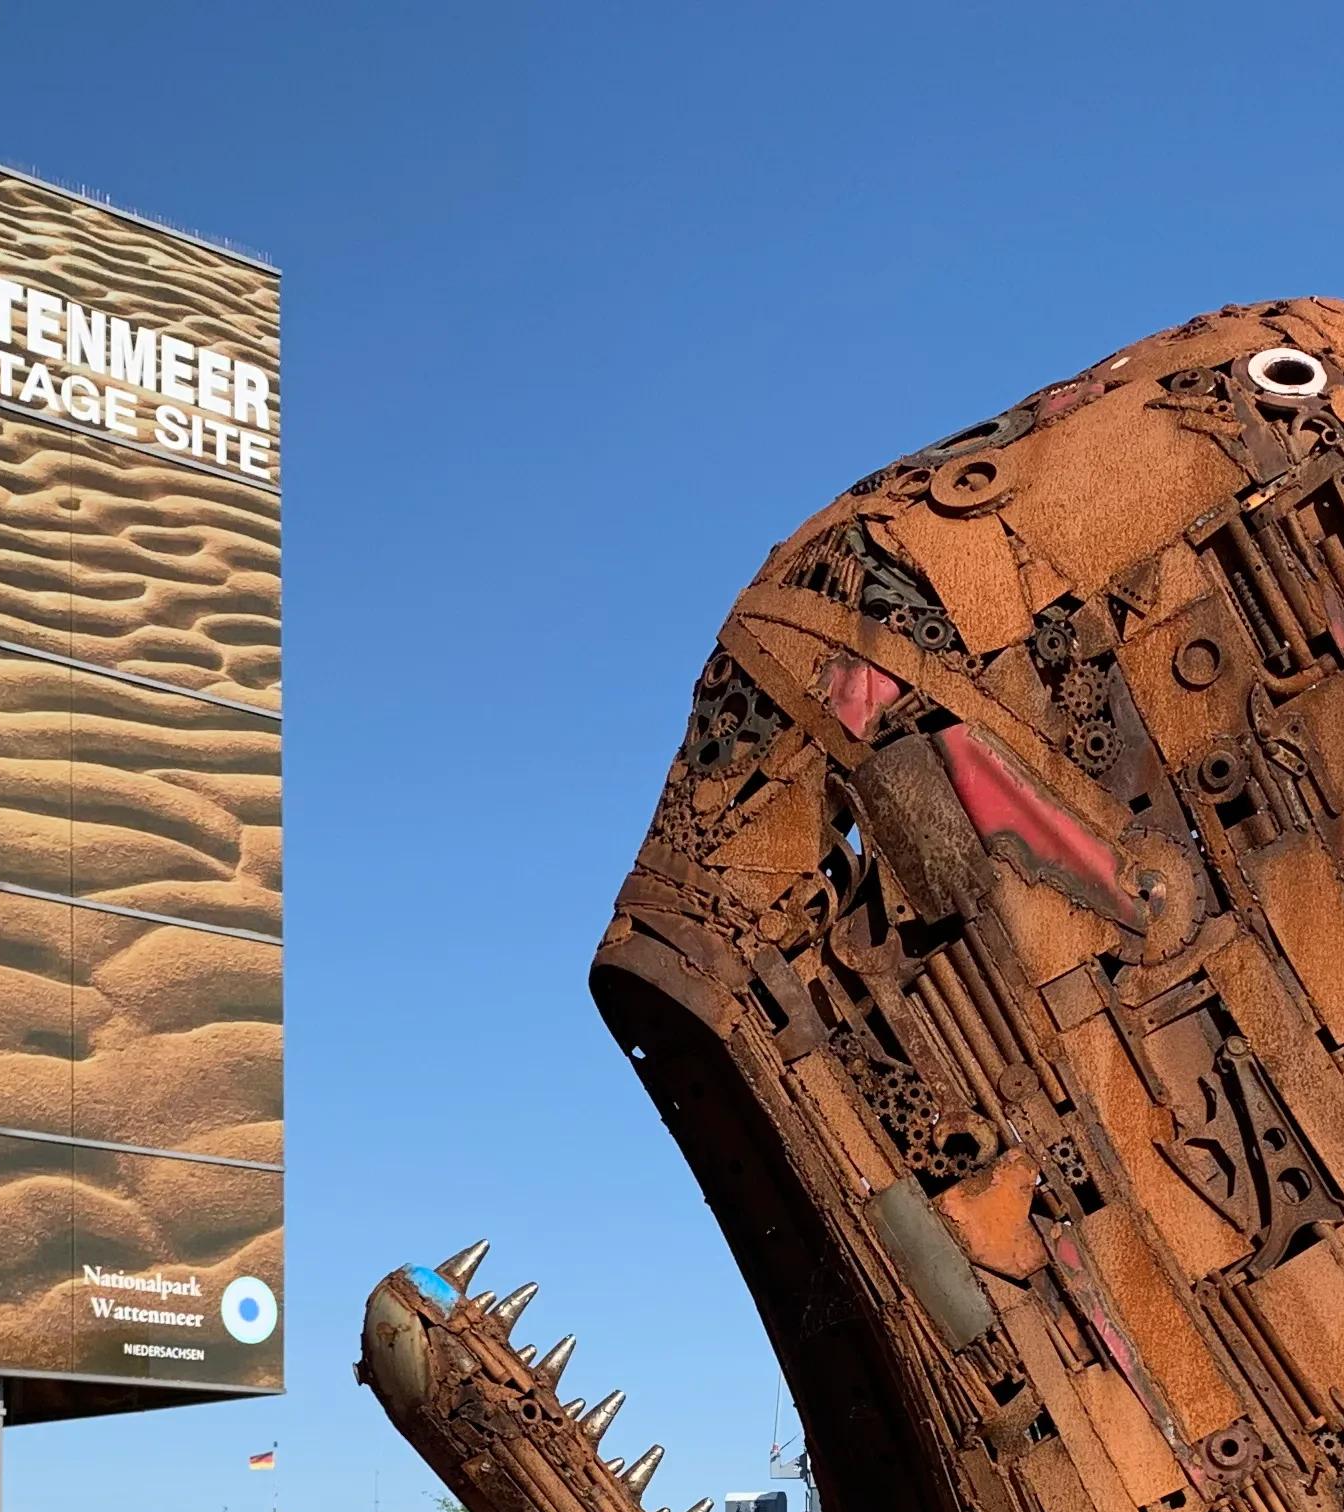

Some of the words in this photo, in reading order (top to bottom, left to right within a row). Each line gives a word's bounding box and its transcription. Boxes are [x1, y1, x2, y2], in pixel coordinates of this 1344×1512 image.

[154, 405, 271, 480] SITE
[82, 1264, 203, 1300] Nationalpark
[89, 1297, 205, 1328] Wattenmeer
[123, 1343, 205, 1361] NIEDERSACHSEN
